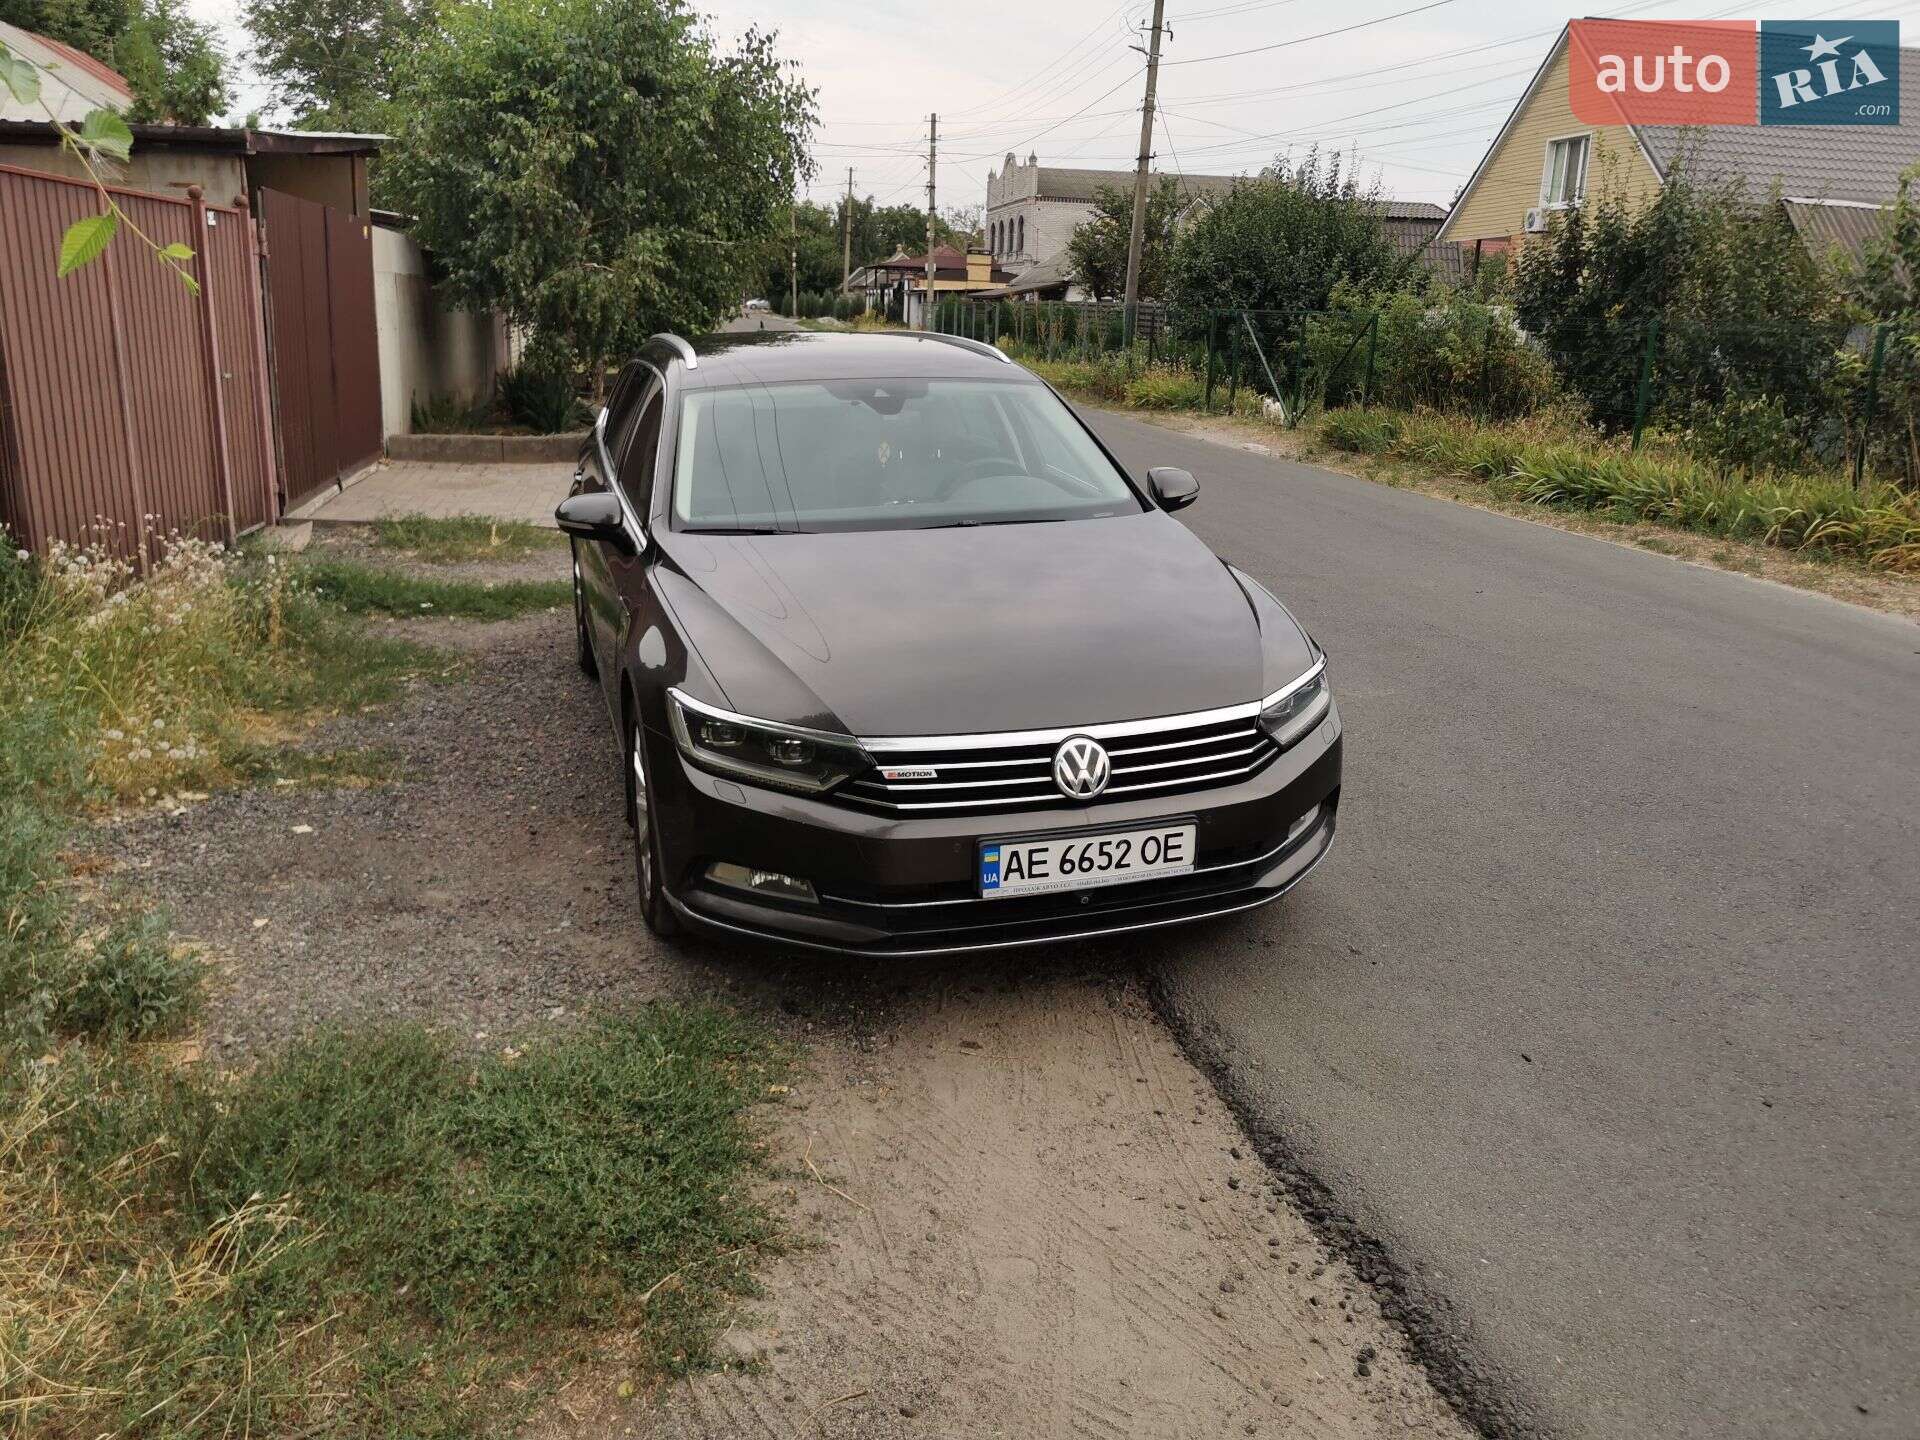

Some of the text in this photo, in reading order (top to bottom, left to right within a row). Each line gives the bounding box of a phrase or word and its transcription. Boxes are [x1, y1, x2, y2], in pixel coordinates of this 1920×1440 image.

[1003, 847, 1050, 881] AE
[1059, 839, 1132, 875] 6652
[1140, 832, 1184, 865] OE
[983, 873, 998, 884] UA
